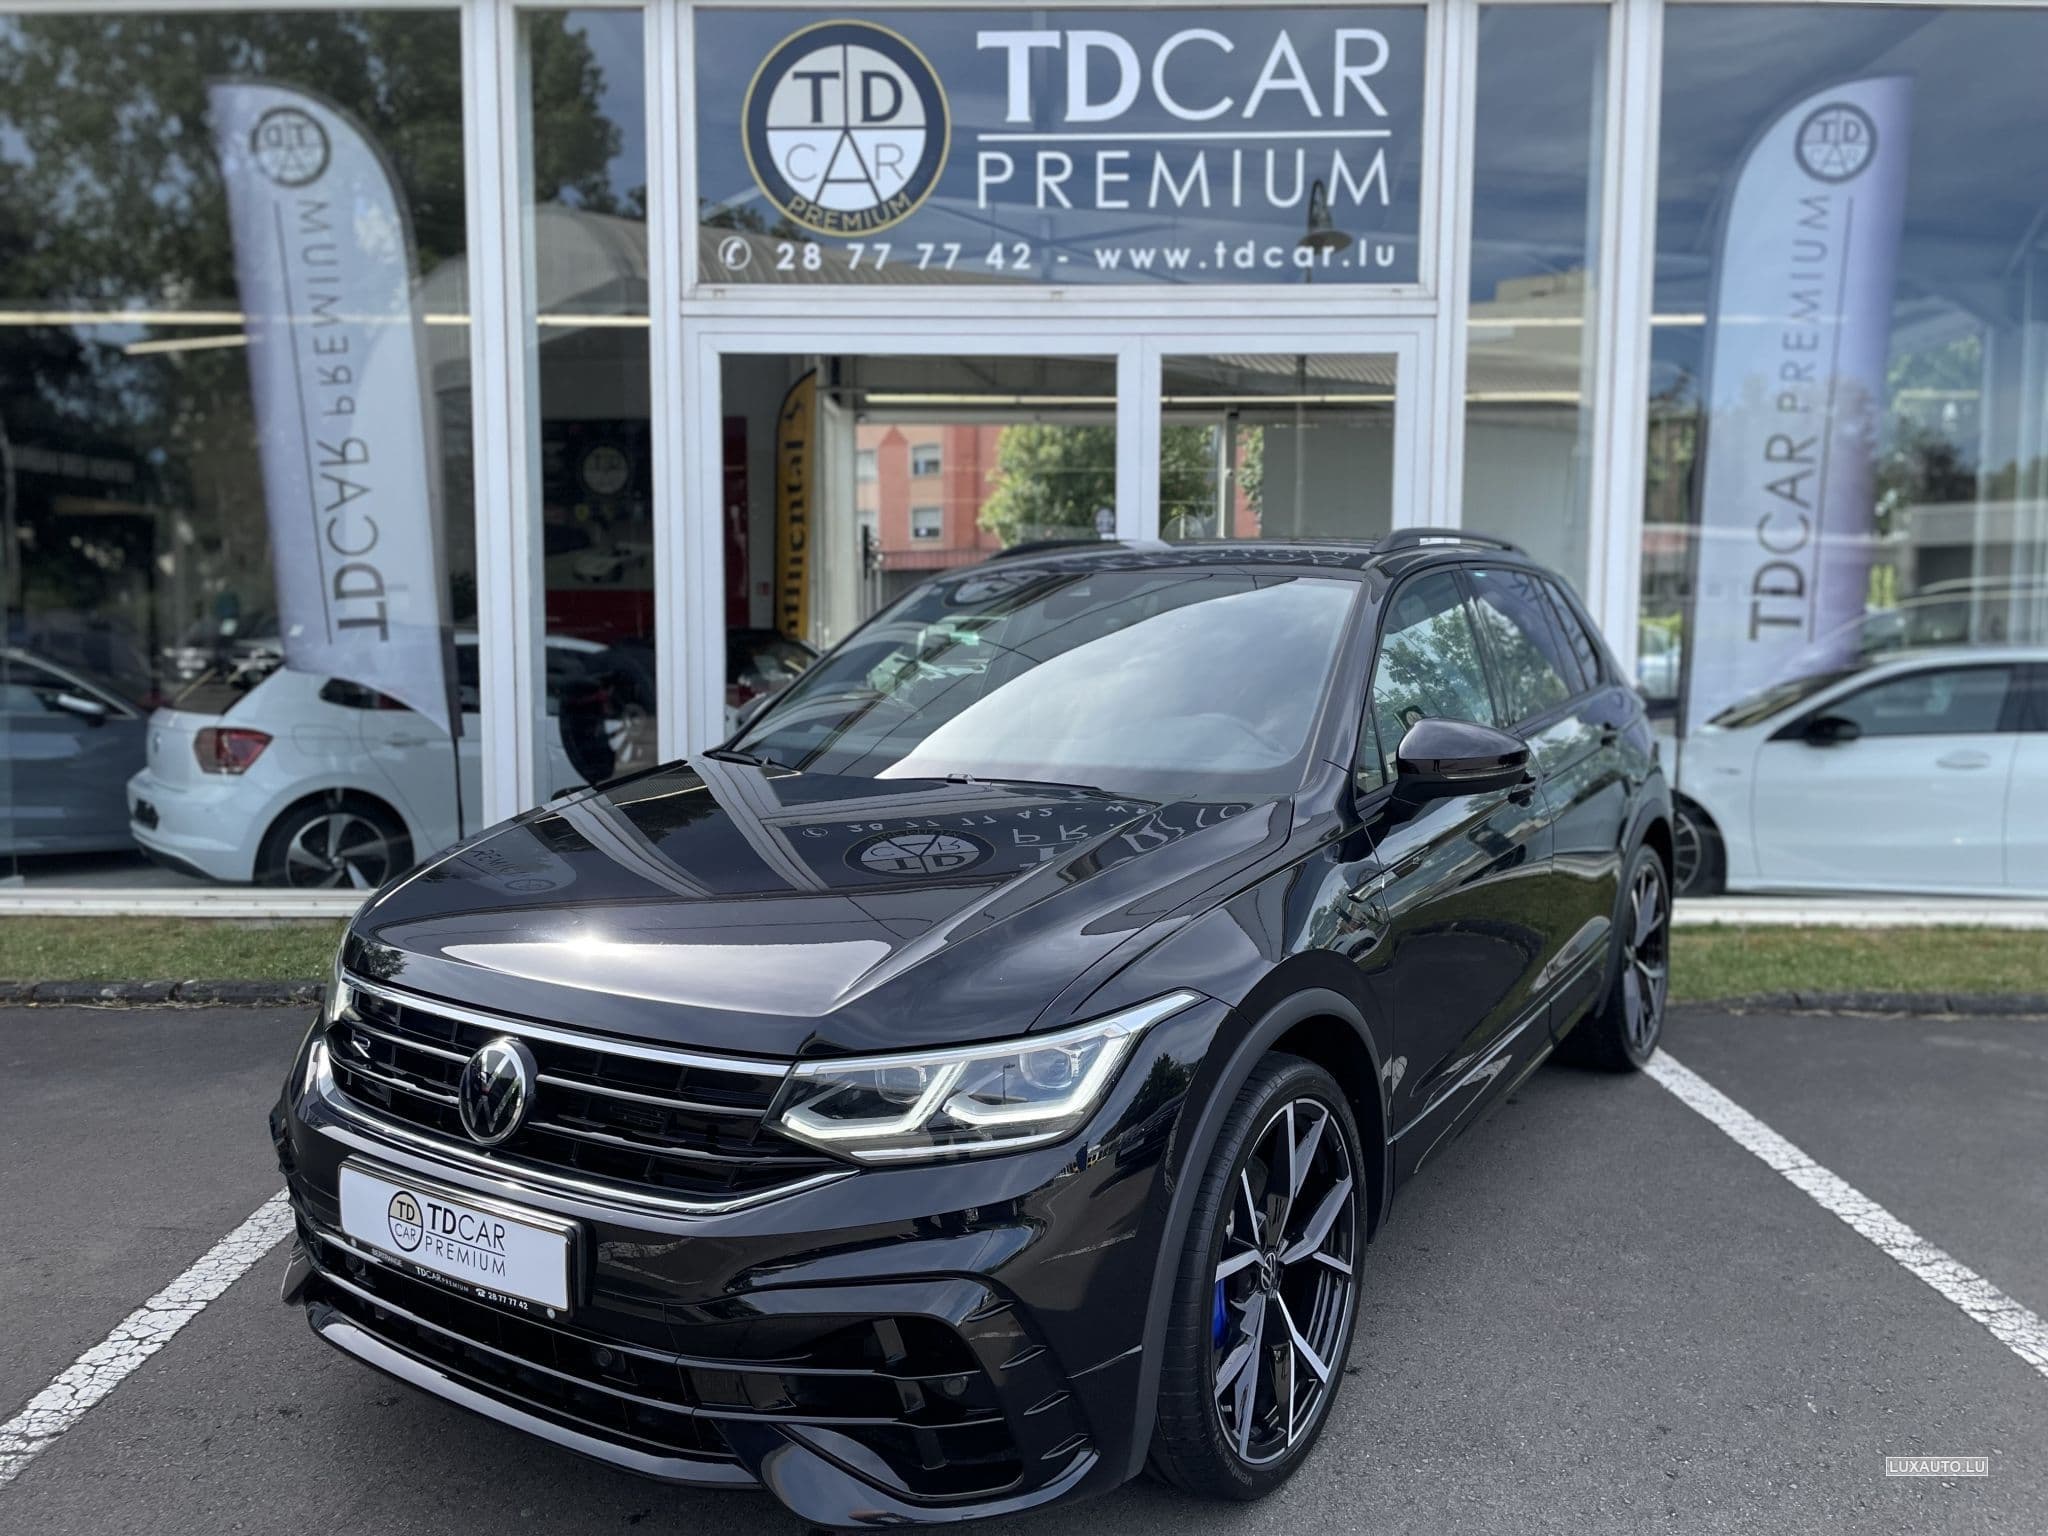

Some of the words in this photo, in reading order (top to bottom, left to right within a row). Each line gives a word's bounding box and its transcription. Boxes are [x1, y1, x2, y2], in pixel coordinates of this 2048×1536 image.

[976, 28, 1389, 123] TDCAR
[978, 148, 1390, 209] PREMIUM
[786, 191, 912, 232] PREMIUM
[776, 242, 823, 271] 28
[847, 242, 892, 271] 77
[917, 242, 962, 271] 77
[985, 242, 1033, 271] 42
[1095, 239, 1396, 271] www.tdcar.lu
[1777, 194, 1832, 413] PREMIUM
[1748, 432, 1818, 642] TDCAR
[396, 1200, 415, 1221] TD
[427, 1202, 505, 1251] TDCAR
[394, 1223, 416, 1242] CAR
[425, 1235, 506, 1277] PREMIUM
[441, 1277, 470, 1292] PREMIUM
[487, 1292, 497, 1301] 28
[518, 1300, 529, 1310] 42
